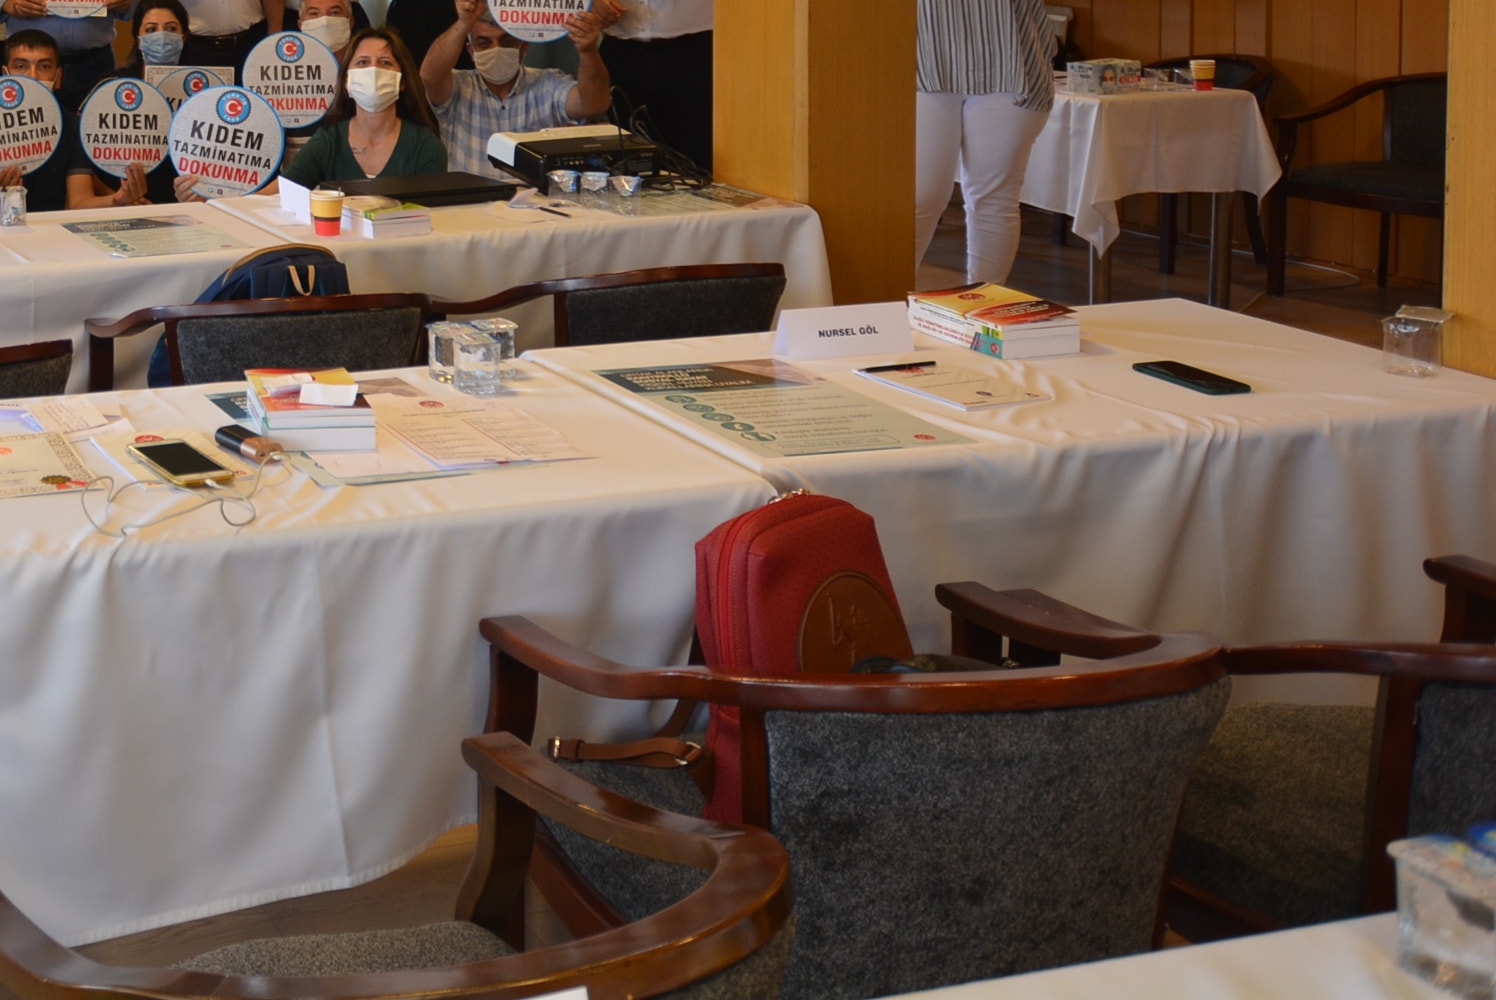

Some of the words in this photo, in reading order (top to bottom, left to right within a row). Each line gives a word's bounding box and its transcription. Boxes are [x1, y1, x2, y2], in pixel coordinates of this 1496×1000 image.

[260, 64, 322, 81] KIDEM
[268, 97, 328, 110] OKUNMA
[98, 112, 158, 130] KIDEM
[86, 132, 168, 146] TAZMİNATIMA
[190, 120, 264, 151] KIDEM
[92, 146, 161, 162] DOKUNMA
[174, 140, 271, 170] TAZMİNATIMA
[178, 156, 260, 186] DOKUNMA
[818, 328, 856, 338] NURSEL
[858, 324, 878, 335] GÖL
